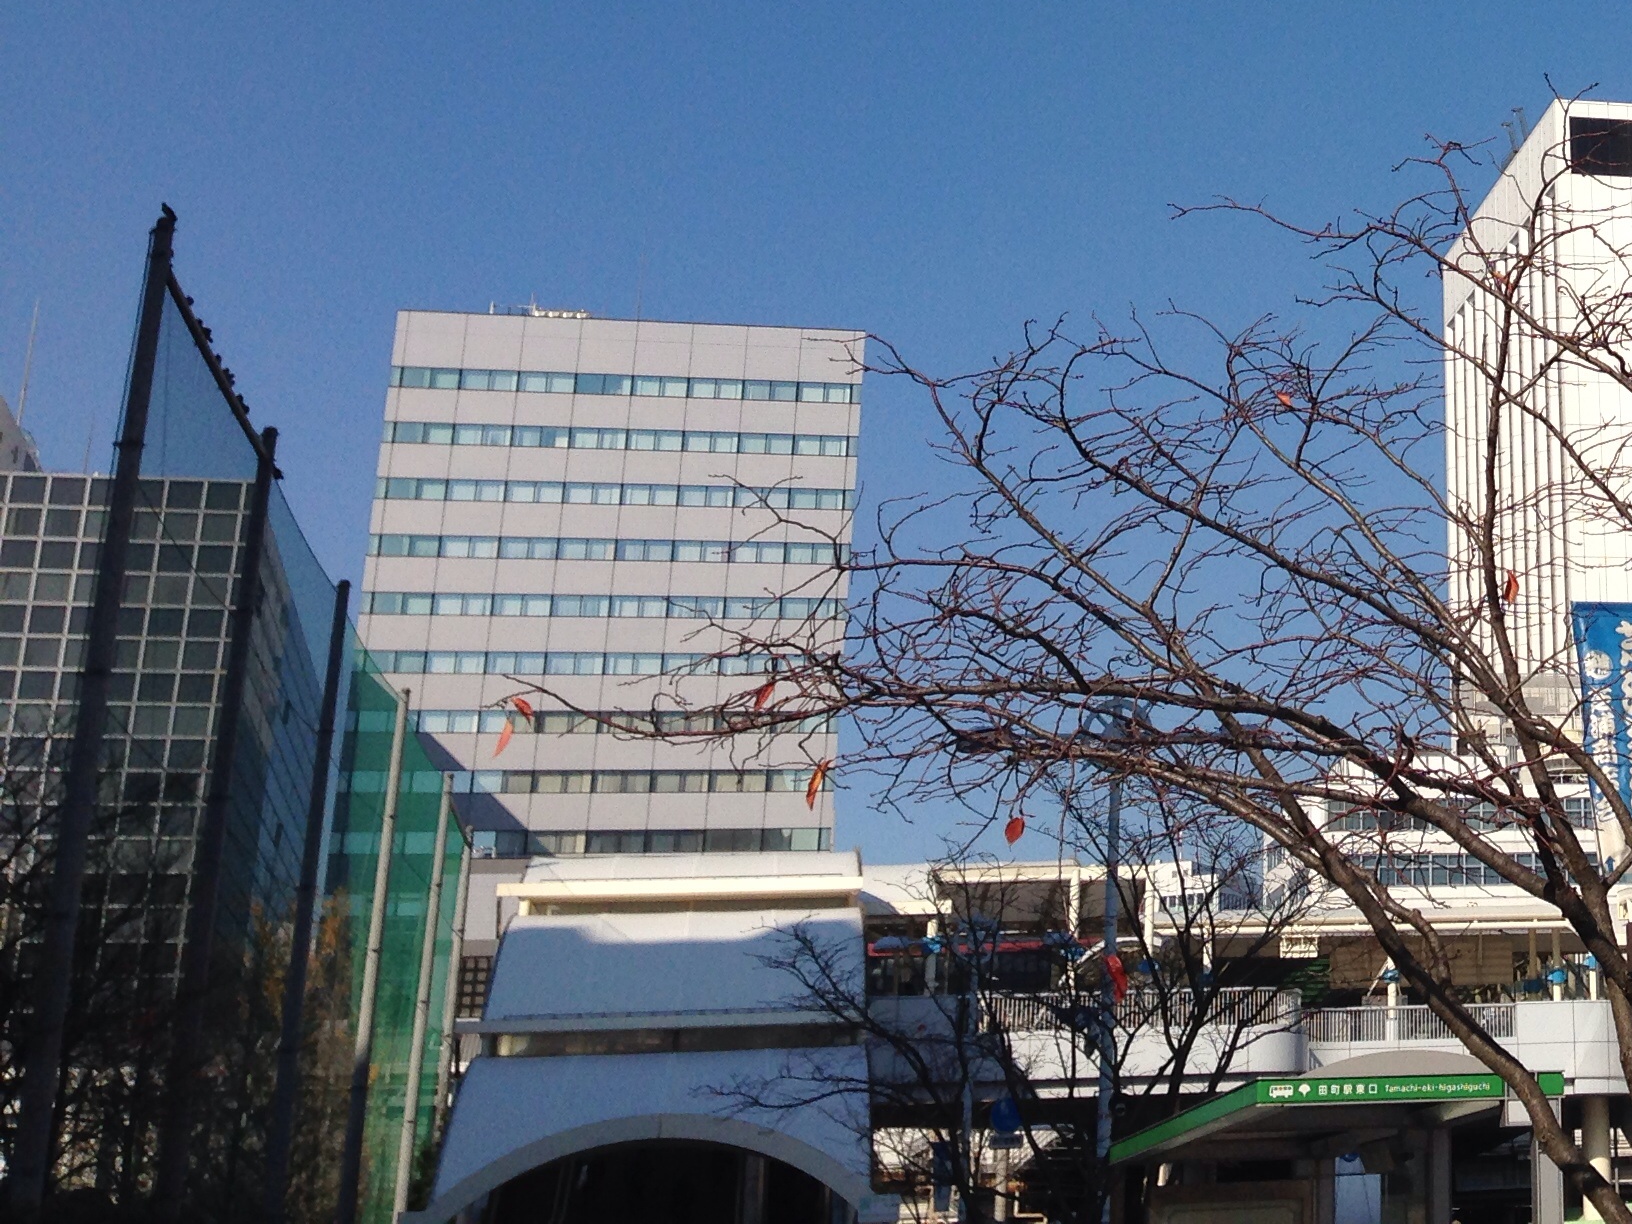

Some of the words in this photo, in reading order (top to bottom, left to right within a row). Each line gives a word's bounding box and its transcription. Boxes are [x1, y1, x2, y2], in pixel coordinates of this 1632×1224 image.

[1318, 1083, 1378, 1096] 田町駅東口
